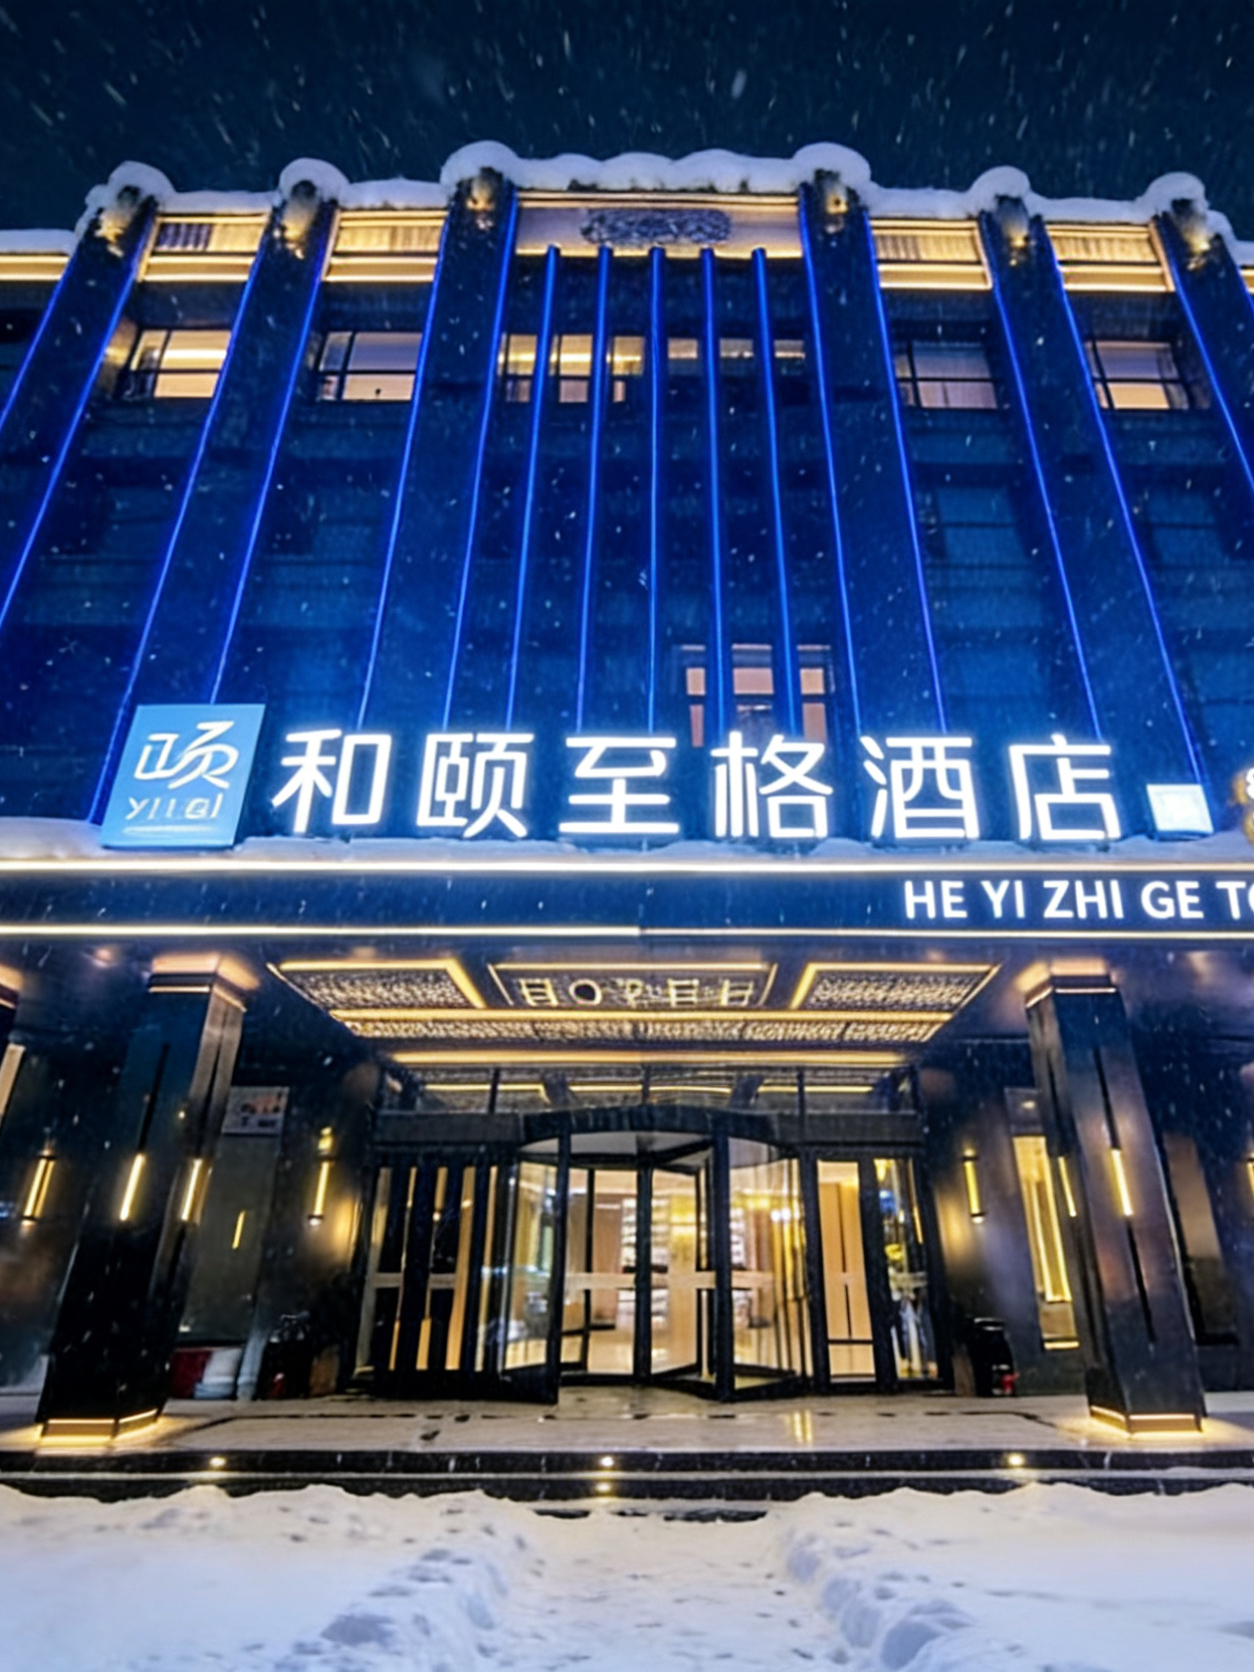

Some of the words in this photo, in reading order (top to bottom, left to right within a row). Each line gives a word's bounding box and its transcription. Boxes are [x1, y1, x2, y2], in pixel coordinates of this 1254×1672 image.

[271, 729, 1121, 841] 和颐至格酒店
[904, 880, 967, 919] HE
[981, 880, 1025, 918] YI
[1043, 880, 1124, 919] ZHI
[1141, 880, 1204, 919] GE
[1215, 880, 1254, 919] T
